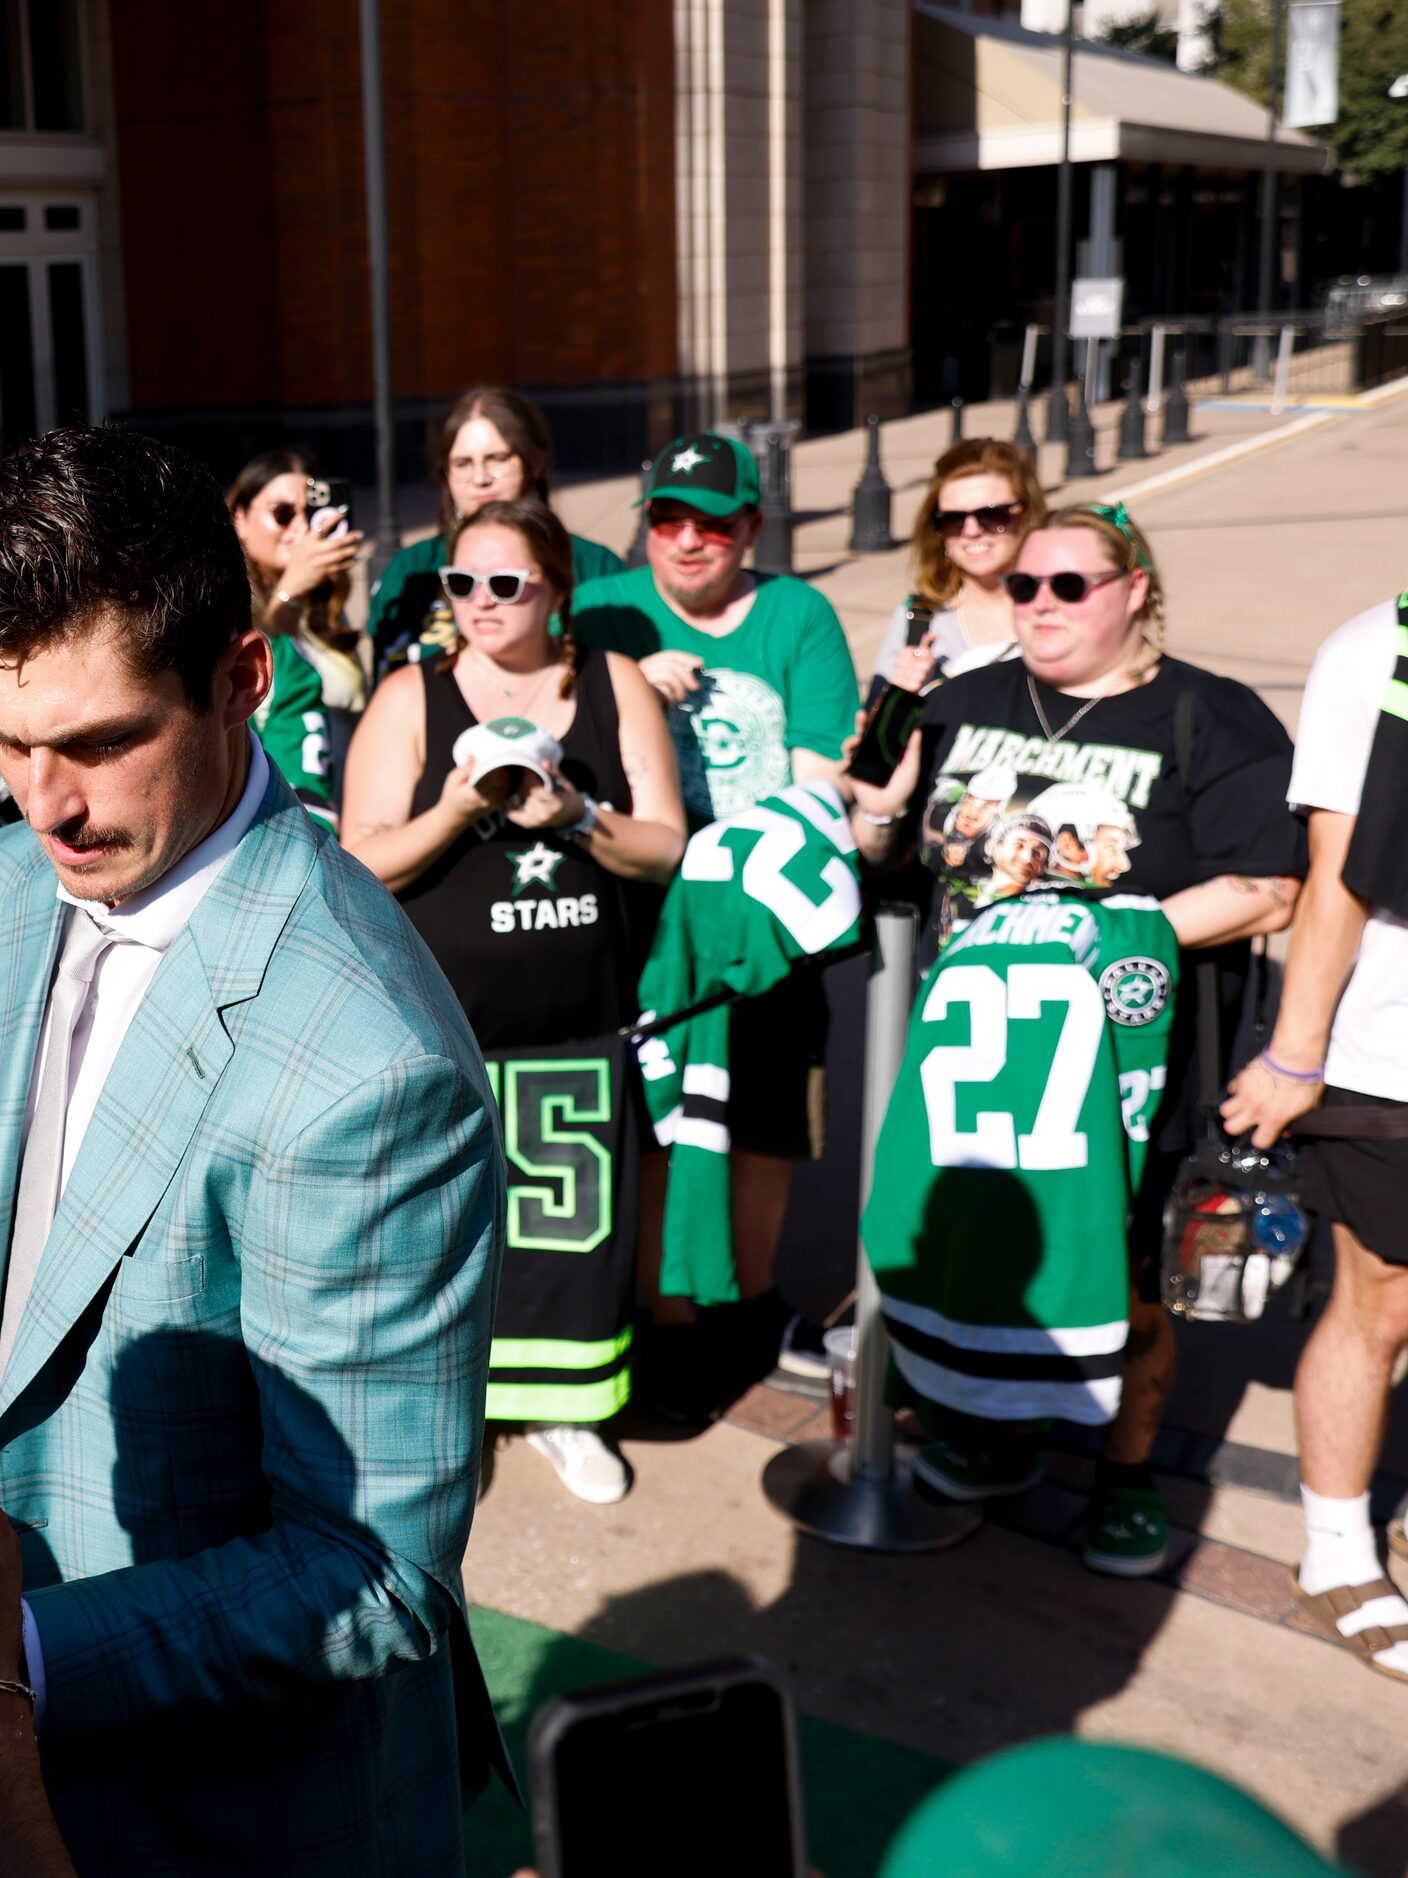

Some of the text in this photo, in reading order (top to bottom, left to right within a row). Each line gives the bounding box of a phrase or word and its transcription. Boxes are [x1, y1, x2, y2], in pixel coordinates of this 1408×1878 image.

[938, 722, 1164, 810] MARCHMENT
[490, 893, 600, 934] STARS
[920, 963, 1106, 1171] 27
[485, 1057, 612, 1254] 5
